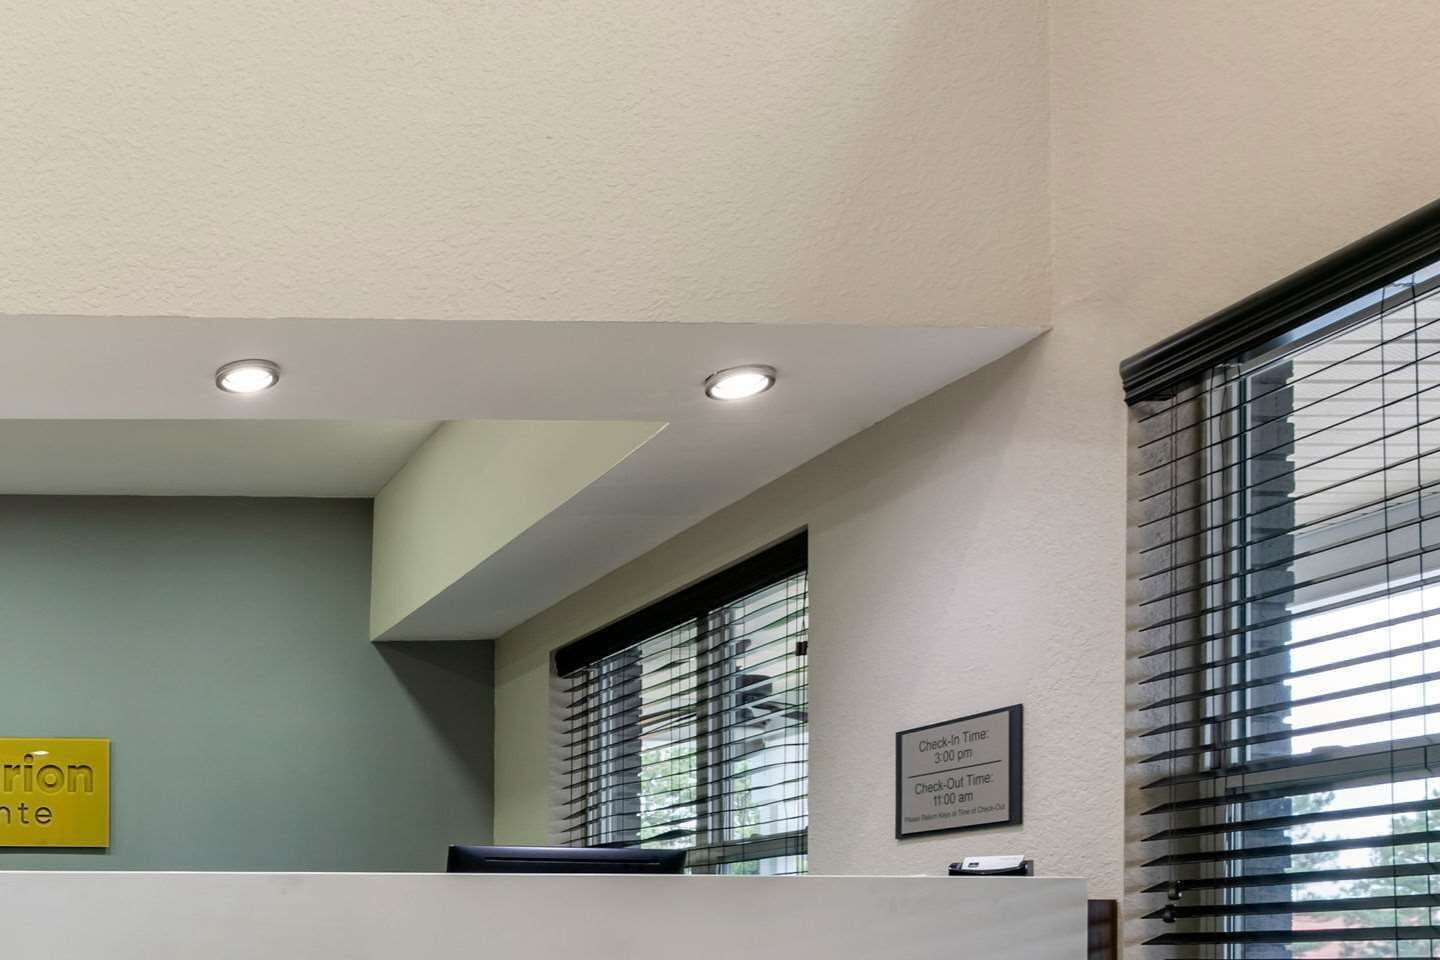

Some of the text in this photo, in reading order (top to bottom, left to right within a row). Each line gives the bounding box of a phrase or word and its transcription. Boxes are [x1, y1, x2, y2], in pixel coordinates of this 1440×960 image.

[919, 729, 990, 752] Check-In Time:
[934, 749, 973, 764] 3:00 pm
[914, 773, 994, 795] Check-Out Time:
[933, 792, 974, 807] 11:00 am
